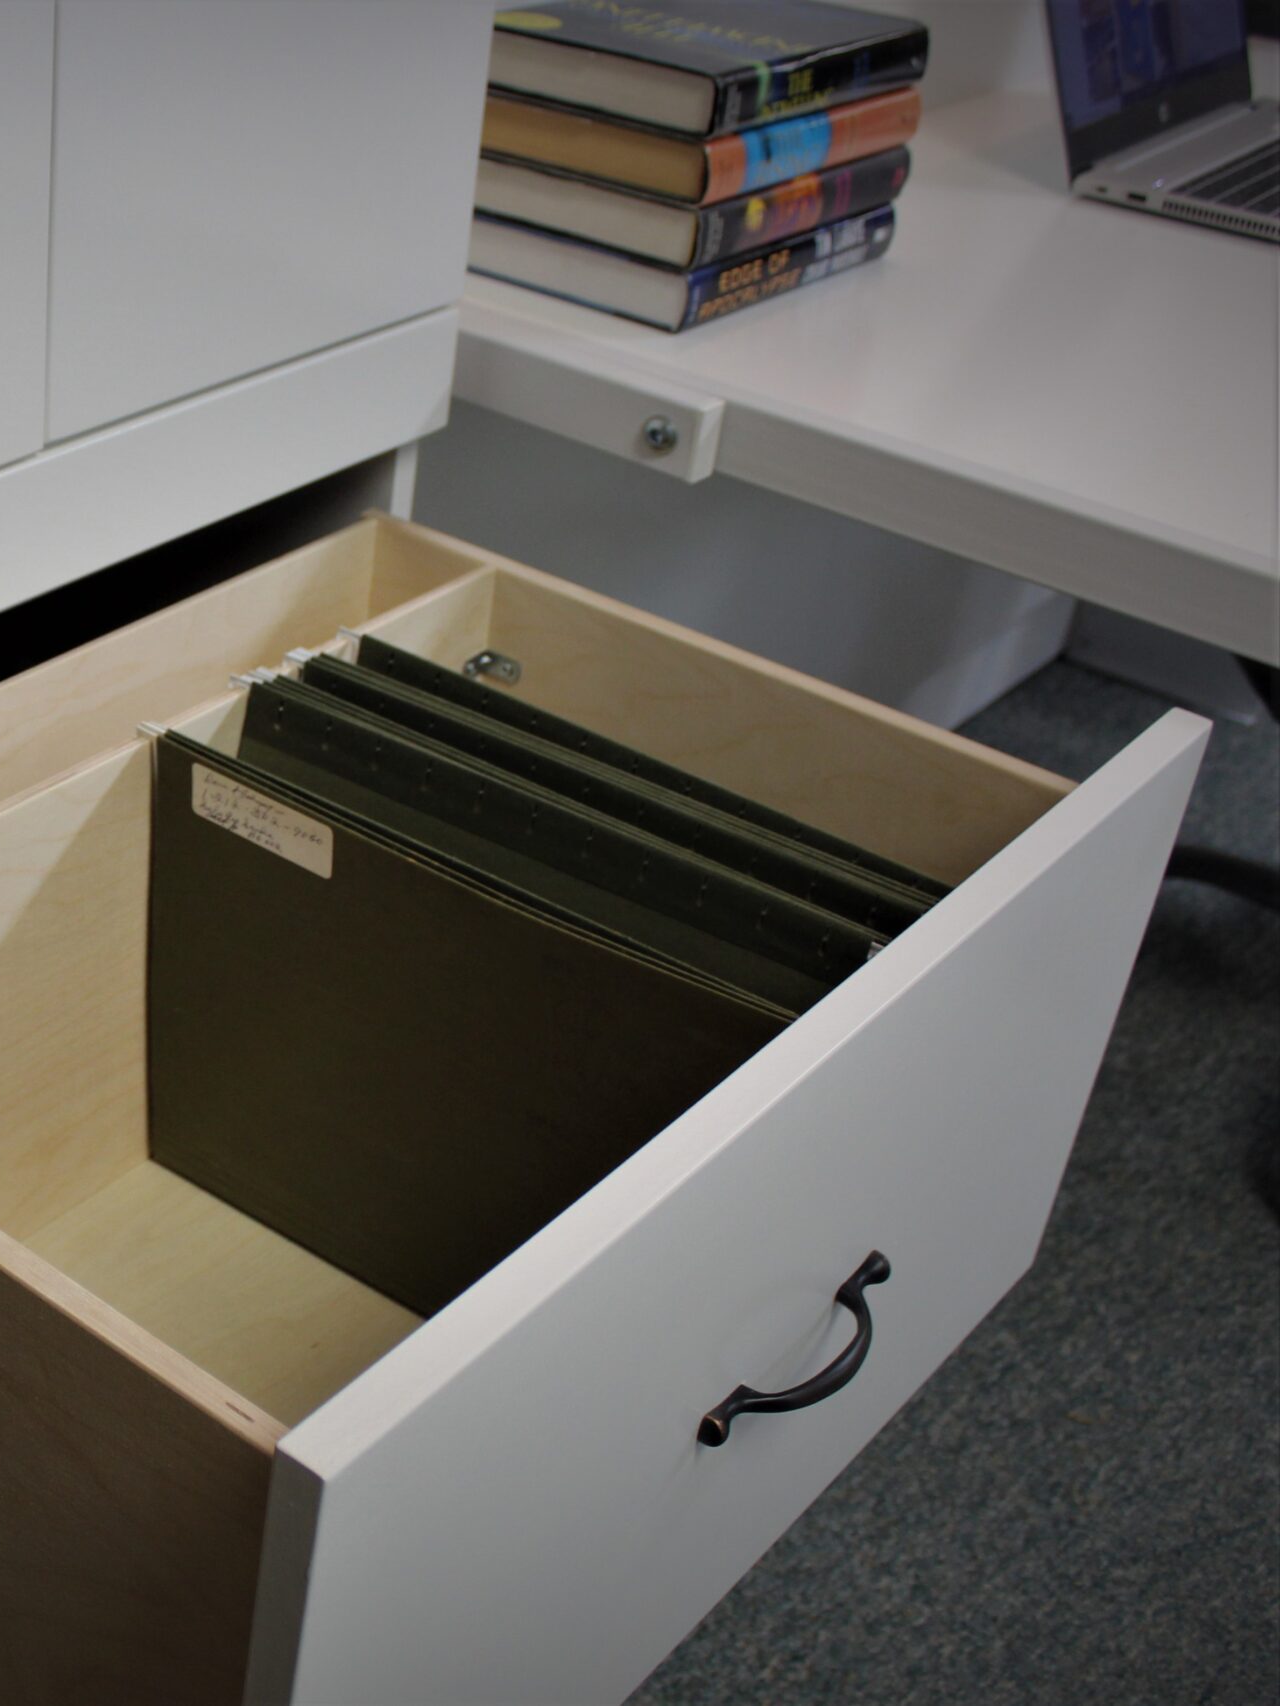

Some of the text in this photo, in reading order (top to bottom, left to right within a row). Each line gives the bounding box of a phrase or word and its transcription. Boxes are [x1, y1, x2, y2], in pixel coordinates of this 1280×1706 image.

[787, 67, 814, 96] THE
[719, 258, 764, 293] EDGE
[768, 248, 791, 274] OF
